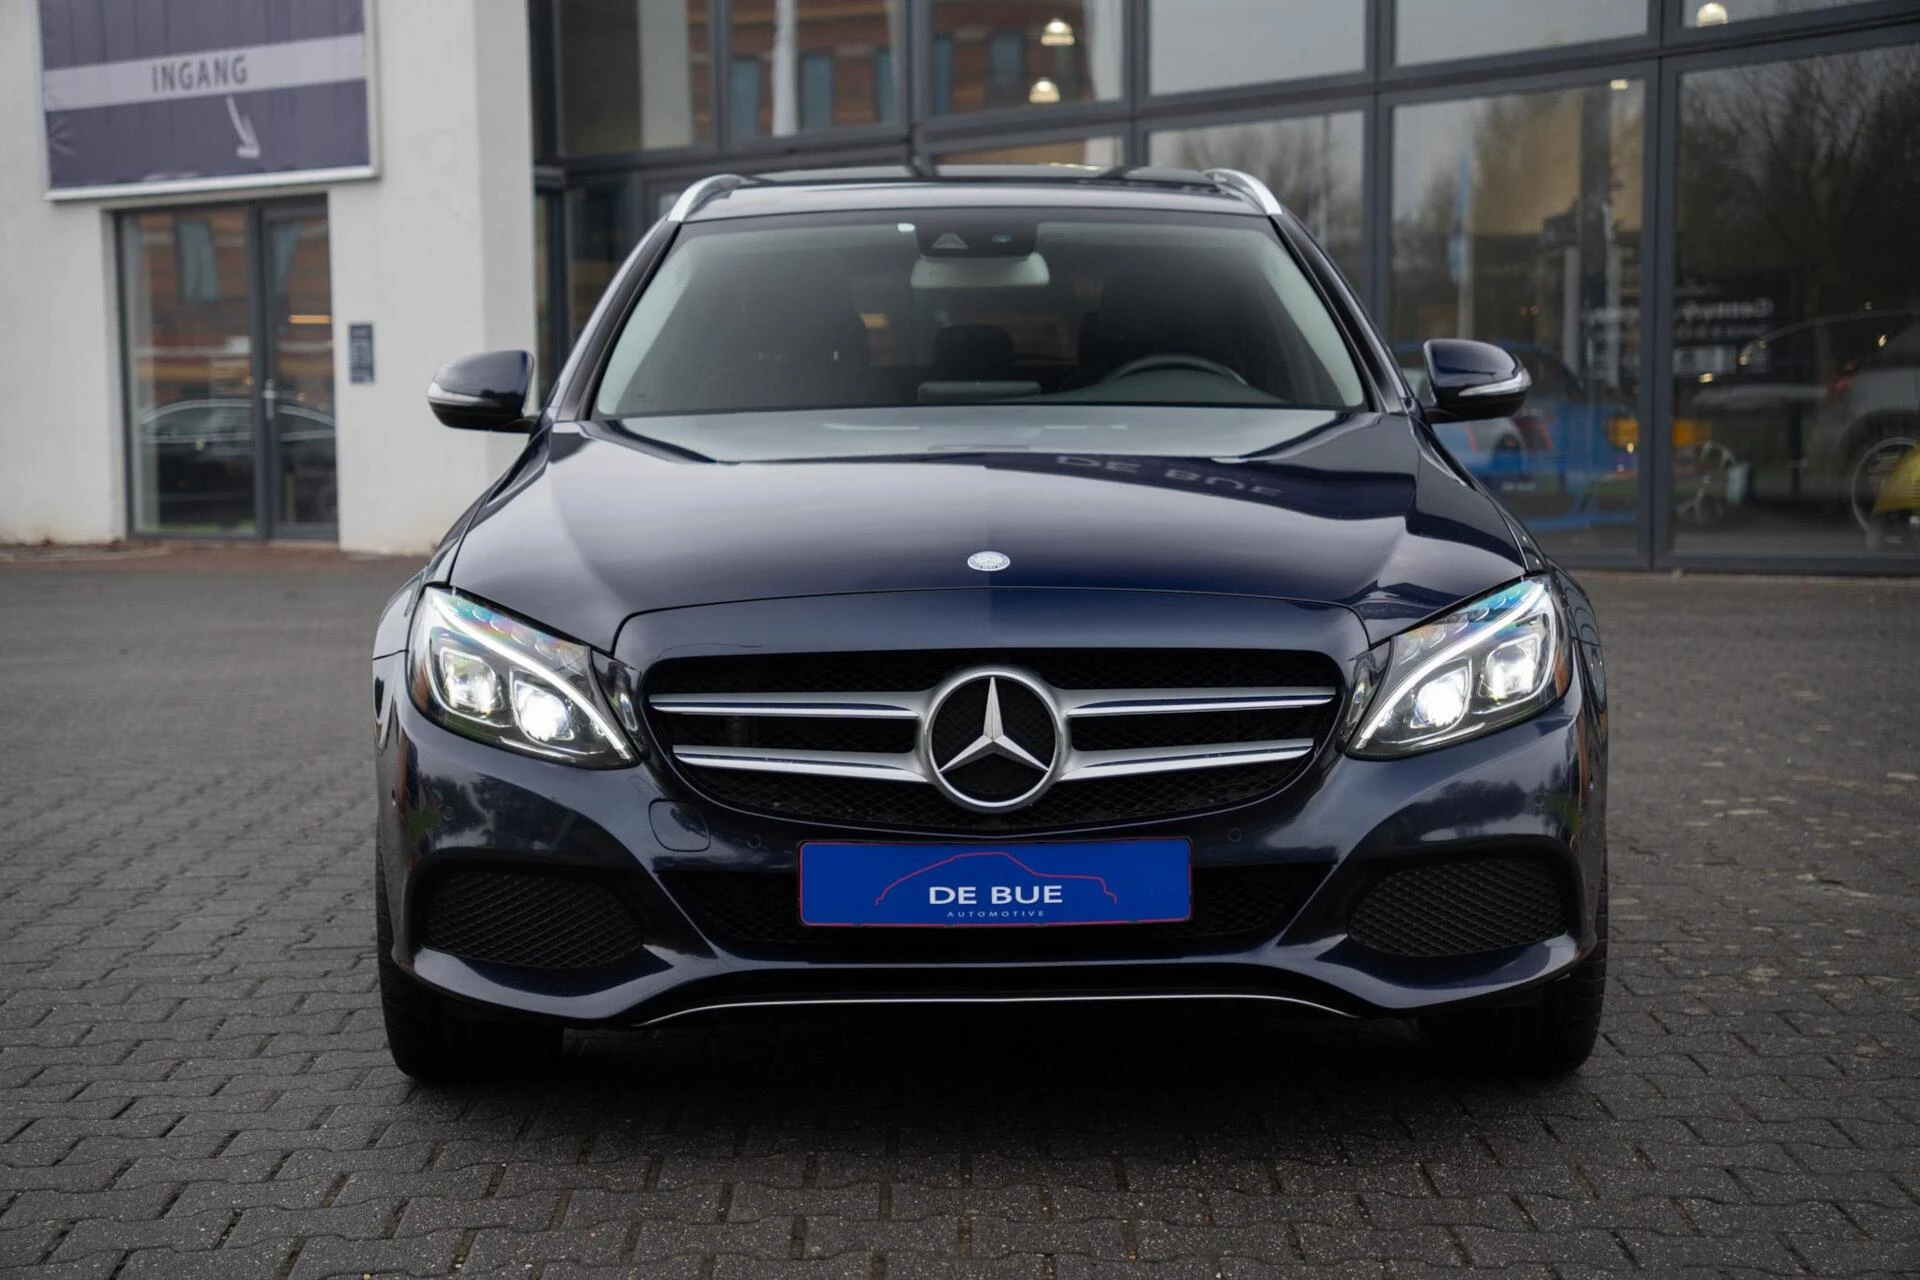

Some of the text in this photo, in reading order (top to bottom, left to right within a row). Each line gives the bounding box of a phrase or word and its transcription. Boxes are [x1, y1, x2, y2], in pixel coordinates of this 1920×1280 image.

[152, 54, 248, 93] INGANG
[929, 885, 1063, 905] DE BUE
[946, 910, 1045, 918] AUTOMOTIVE
